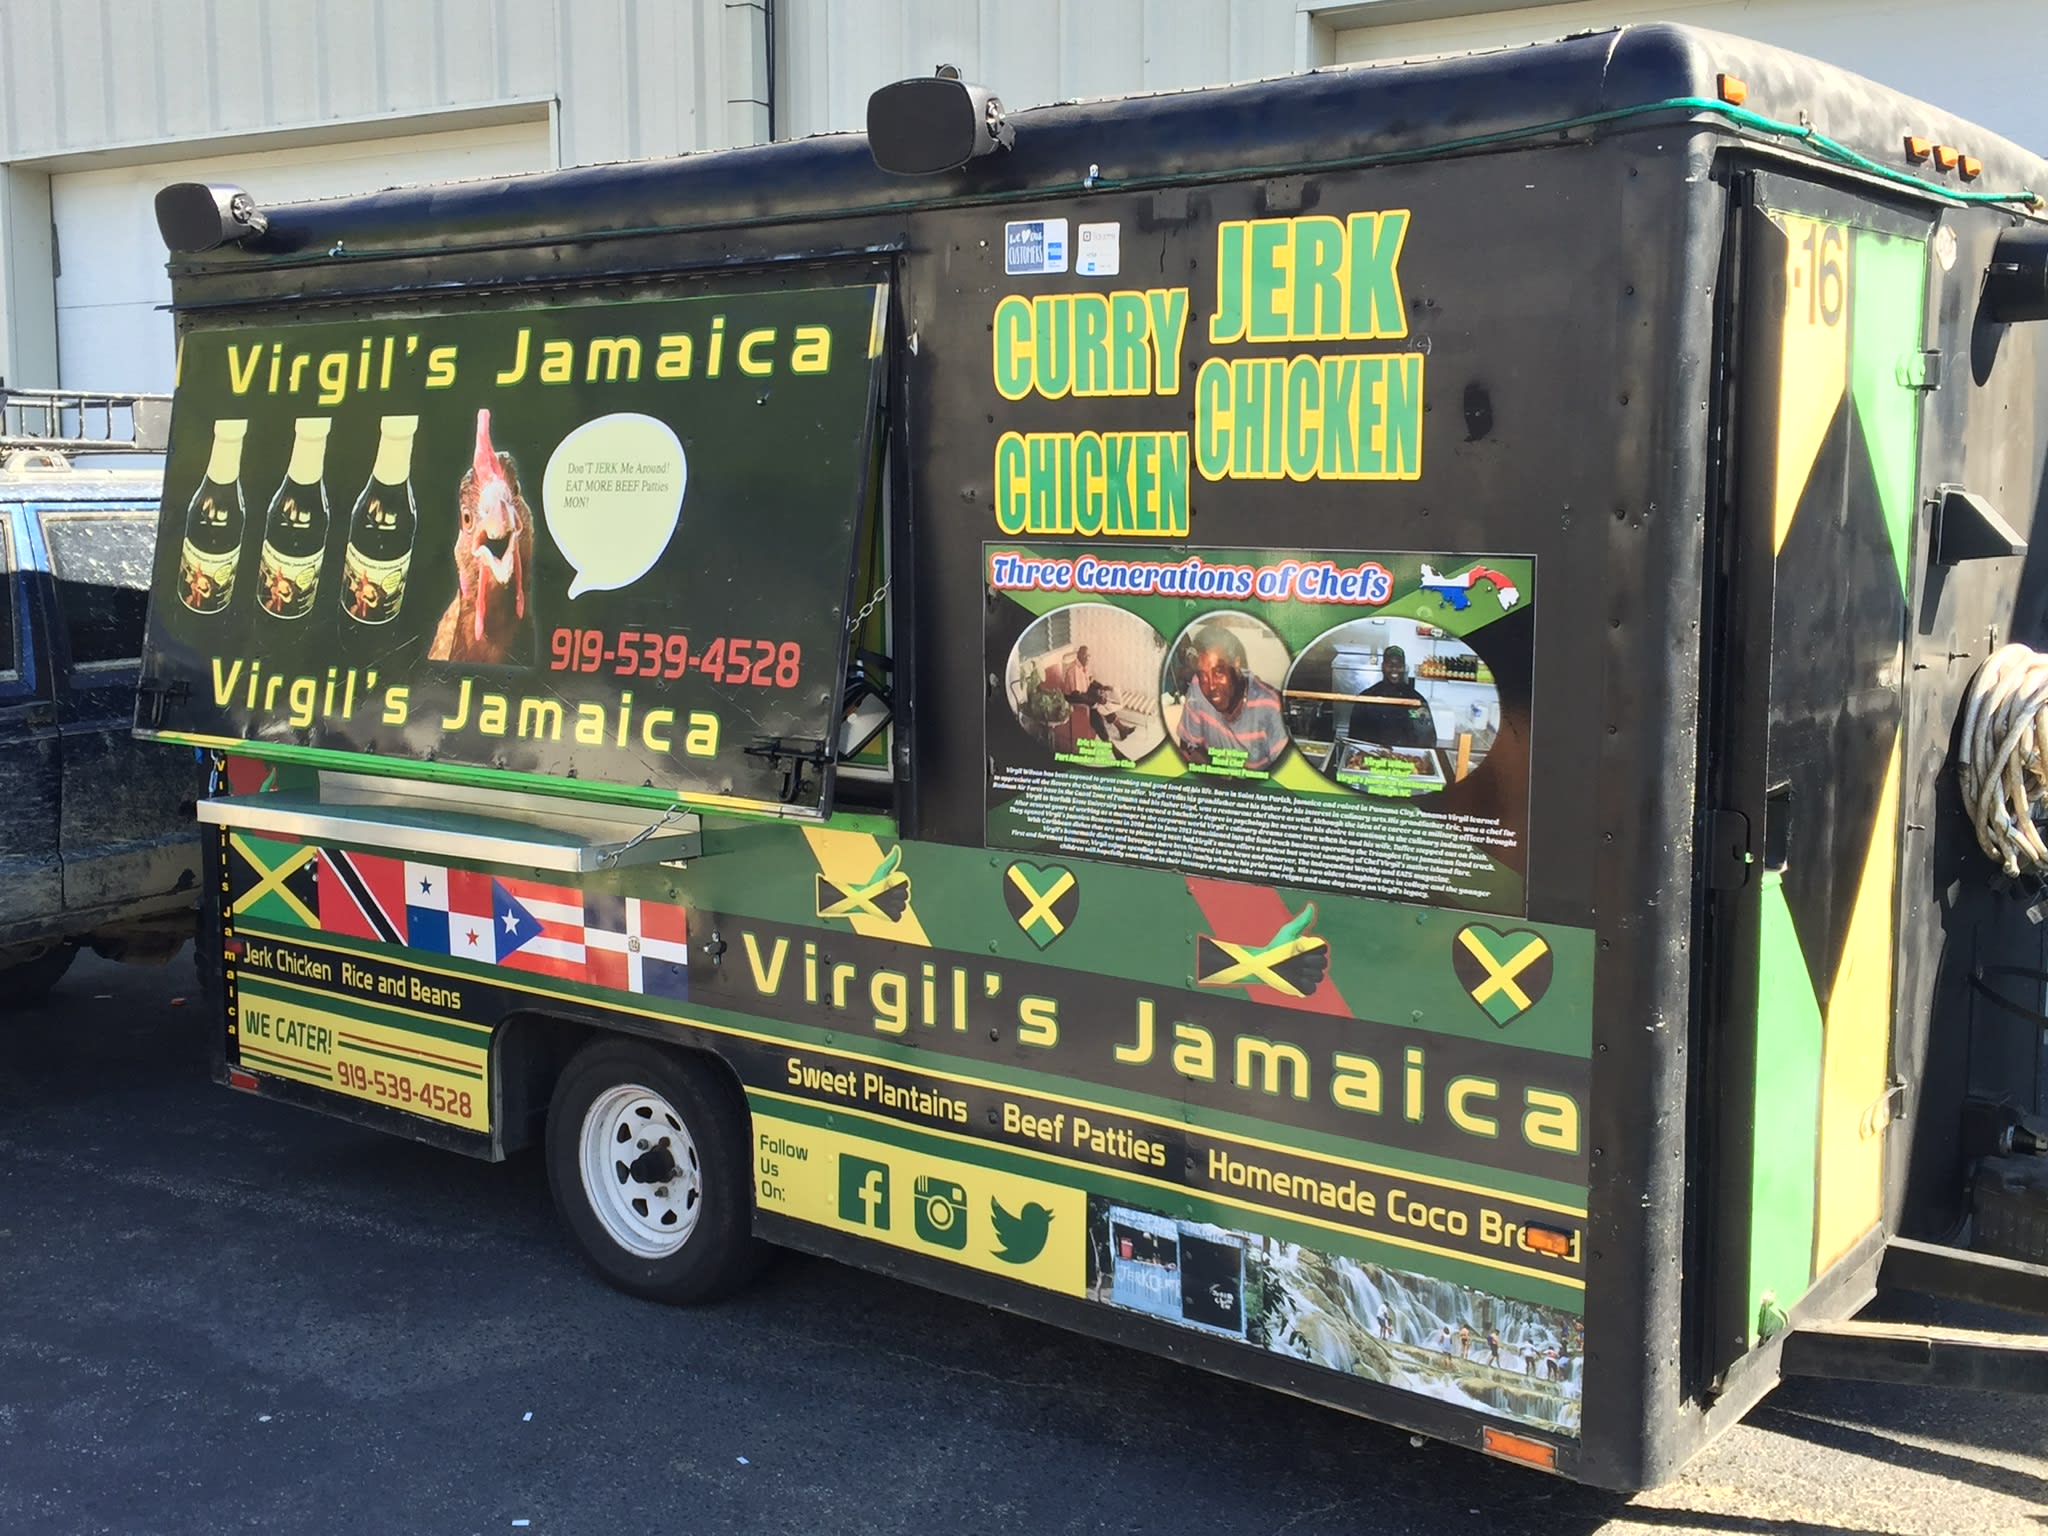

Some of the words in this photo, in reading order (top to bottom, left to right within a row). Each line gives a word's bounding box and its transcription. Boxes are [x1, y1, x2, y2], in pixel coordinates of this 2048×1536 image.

[1209, 209, 1411, 344] JERK
[227, 335, 458, 406] Virgil's
[496, 314, 832, 385] Jamaica
[993, 288, 1189, 400] CURRY
[1194, 352, 1424, 482] CHICKEN
[566, 480, 584, 492] EAT
[585, 480, 614, 492] MORE
[615, 480, 640, 492] BEEF
[641, 480, 669, 492] Patties
[594, 462, 618, 474] JERK
[620, 462, 634, 474] Me
[994, 431, 1190, 536] CHICKEN
[992, 554, 1072, 589] Three
[1075, 556, 1251, 596] Generations
[1256, 563, 1296, 597] of
[1297, 562, 1391, 604] Chefs
[550, 627, 801, 689] 919-539-4528
[212, 656, 410, 728] Virgil's
[441, 675, 721, 758] Jamaica
[243, 942, 273, 970] Jerk
[276, 948, 332, 983] Chicken
[341, 962, 373, 991] Rice
[377, 971, 407, 999] and
[410, 976, 461, 1010] Beans
[244, 1009, 271, 1037] WE
[275, 1016, 333, 1056] CATER!
[741, 930, 1061, 1048] Virgil's
[1113, 997, 1582, 1155] Jamaica
[337, 1061, 473, 1119] 919-539-4528
[760, 1135, 809, 1161] Follow
[761, 1161, 779, 1177] Us
[786, 1057, 857, 1098] Sweet
[863, 1072, 968, 1124] Plantains
[1003, 1103, 1064, 1144] Beef
[1072, 1118, 1167, 1168] Patties
[1208, 1148, 1376, 1218] Homemade
[1387, 1188, 1468, 1238] Coco
[1479, 1207, 1581, 1264] Bred
[761, 1180, 786, 1202] On:
